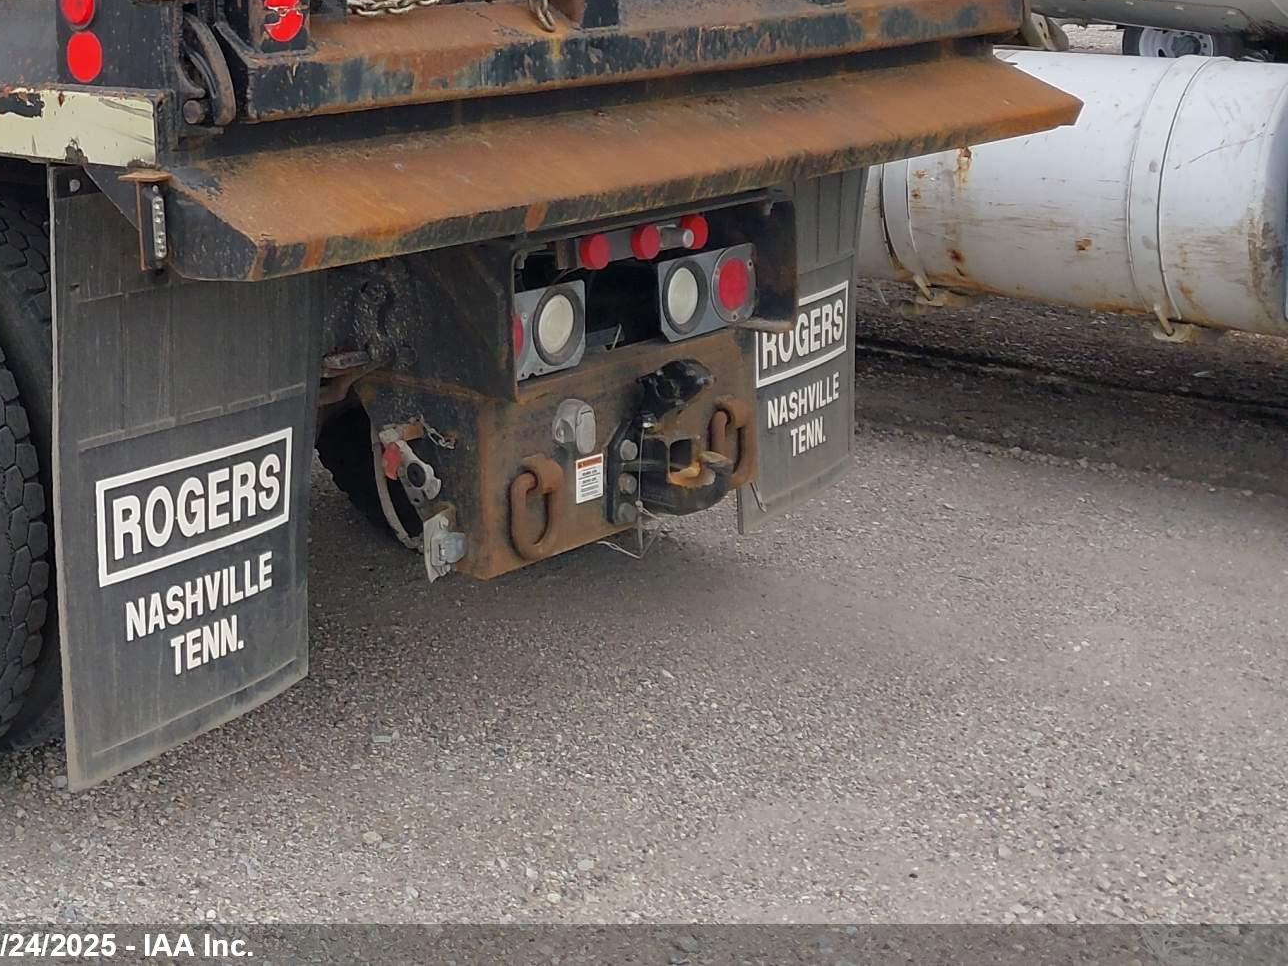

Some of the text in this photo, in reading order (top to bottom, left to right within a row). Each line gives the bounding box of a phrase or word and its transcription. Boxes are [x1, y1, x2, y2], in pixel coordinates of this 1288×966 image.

[762, 298, 844, 370] ROGERS
[767, 371, 840, 429] NASHVILLE
[790, 416, 826, 457] TENN.
[113, 454, 281, 561] ROGERS
[126, 551, 273, 642] NASHVILLE
[171, 615, 245, 676] TENN.
